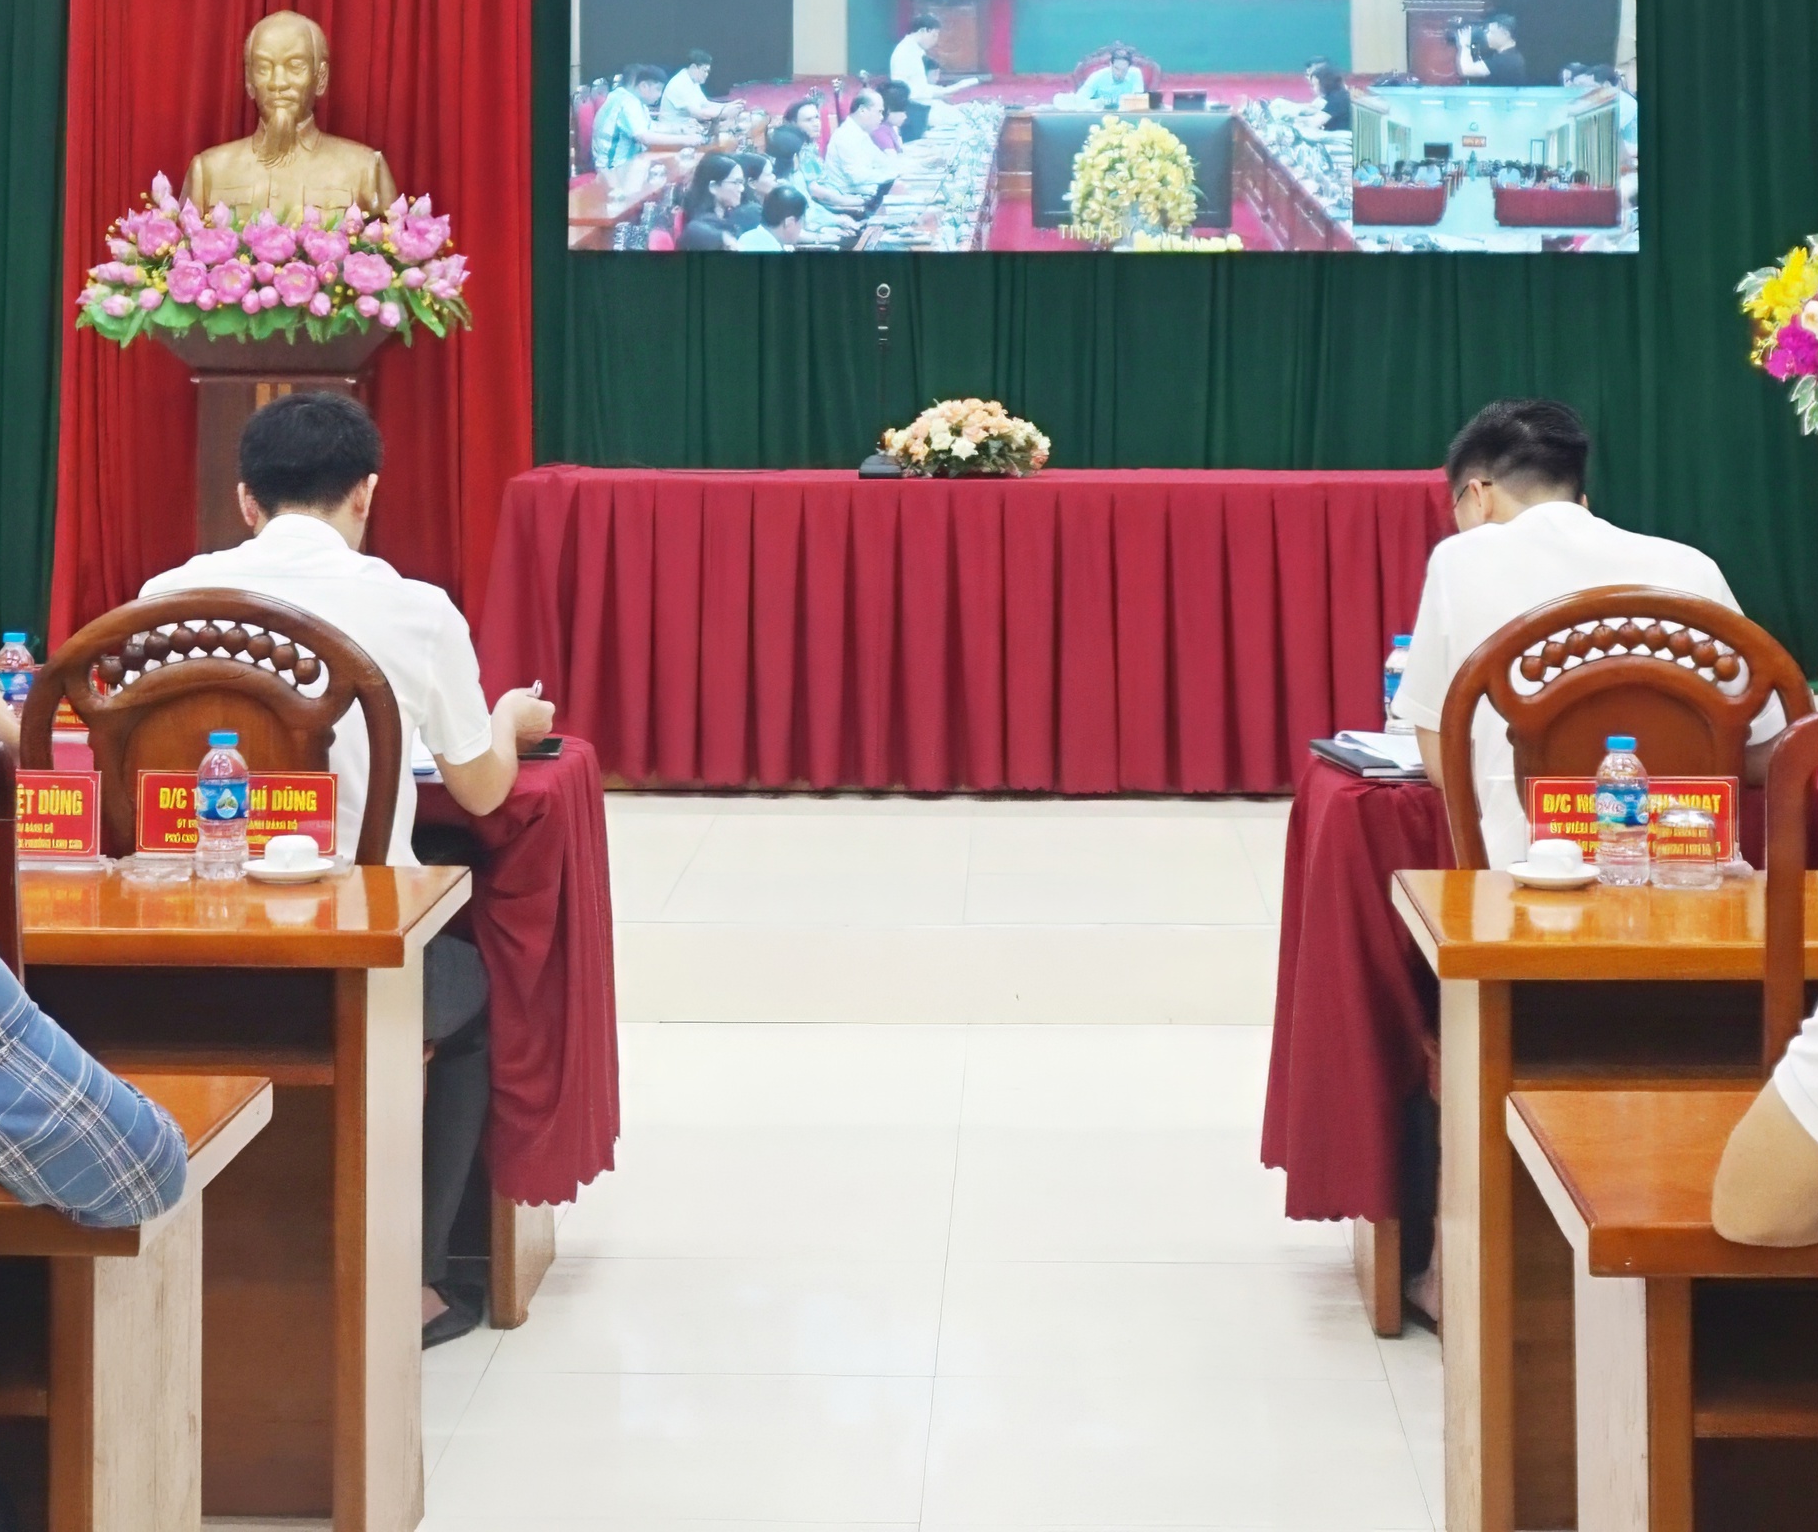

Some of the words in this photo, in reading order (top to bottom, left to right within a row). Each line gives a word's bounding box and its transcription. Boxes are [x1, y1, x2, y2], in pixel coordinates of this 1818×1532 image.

[38, 785, 83, 816] DŨNG
[159, 787, 188, 810] Đ/C
[271, 786, 318, 812] DŨNG
